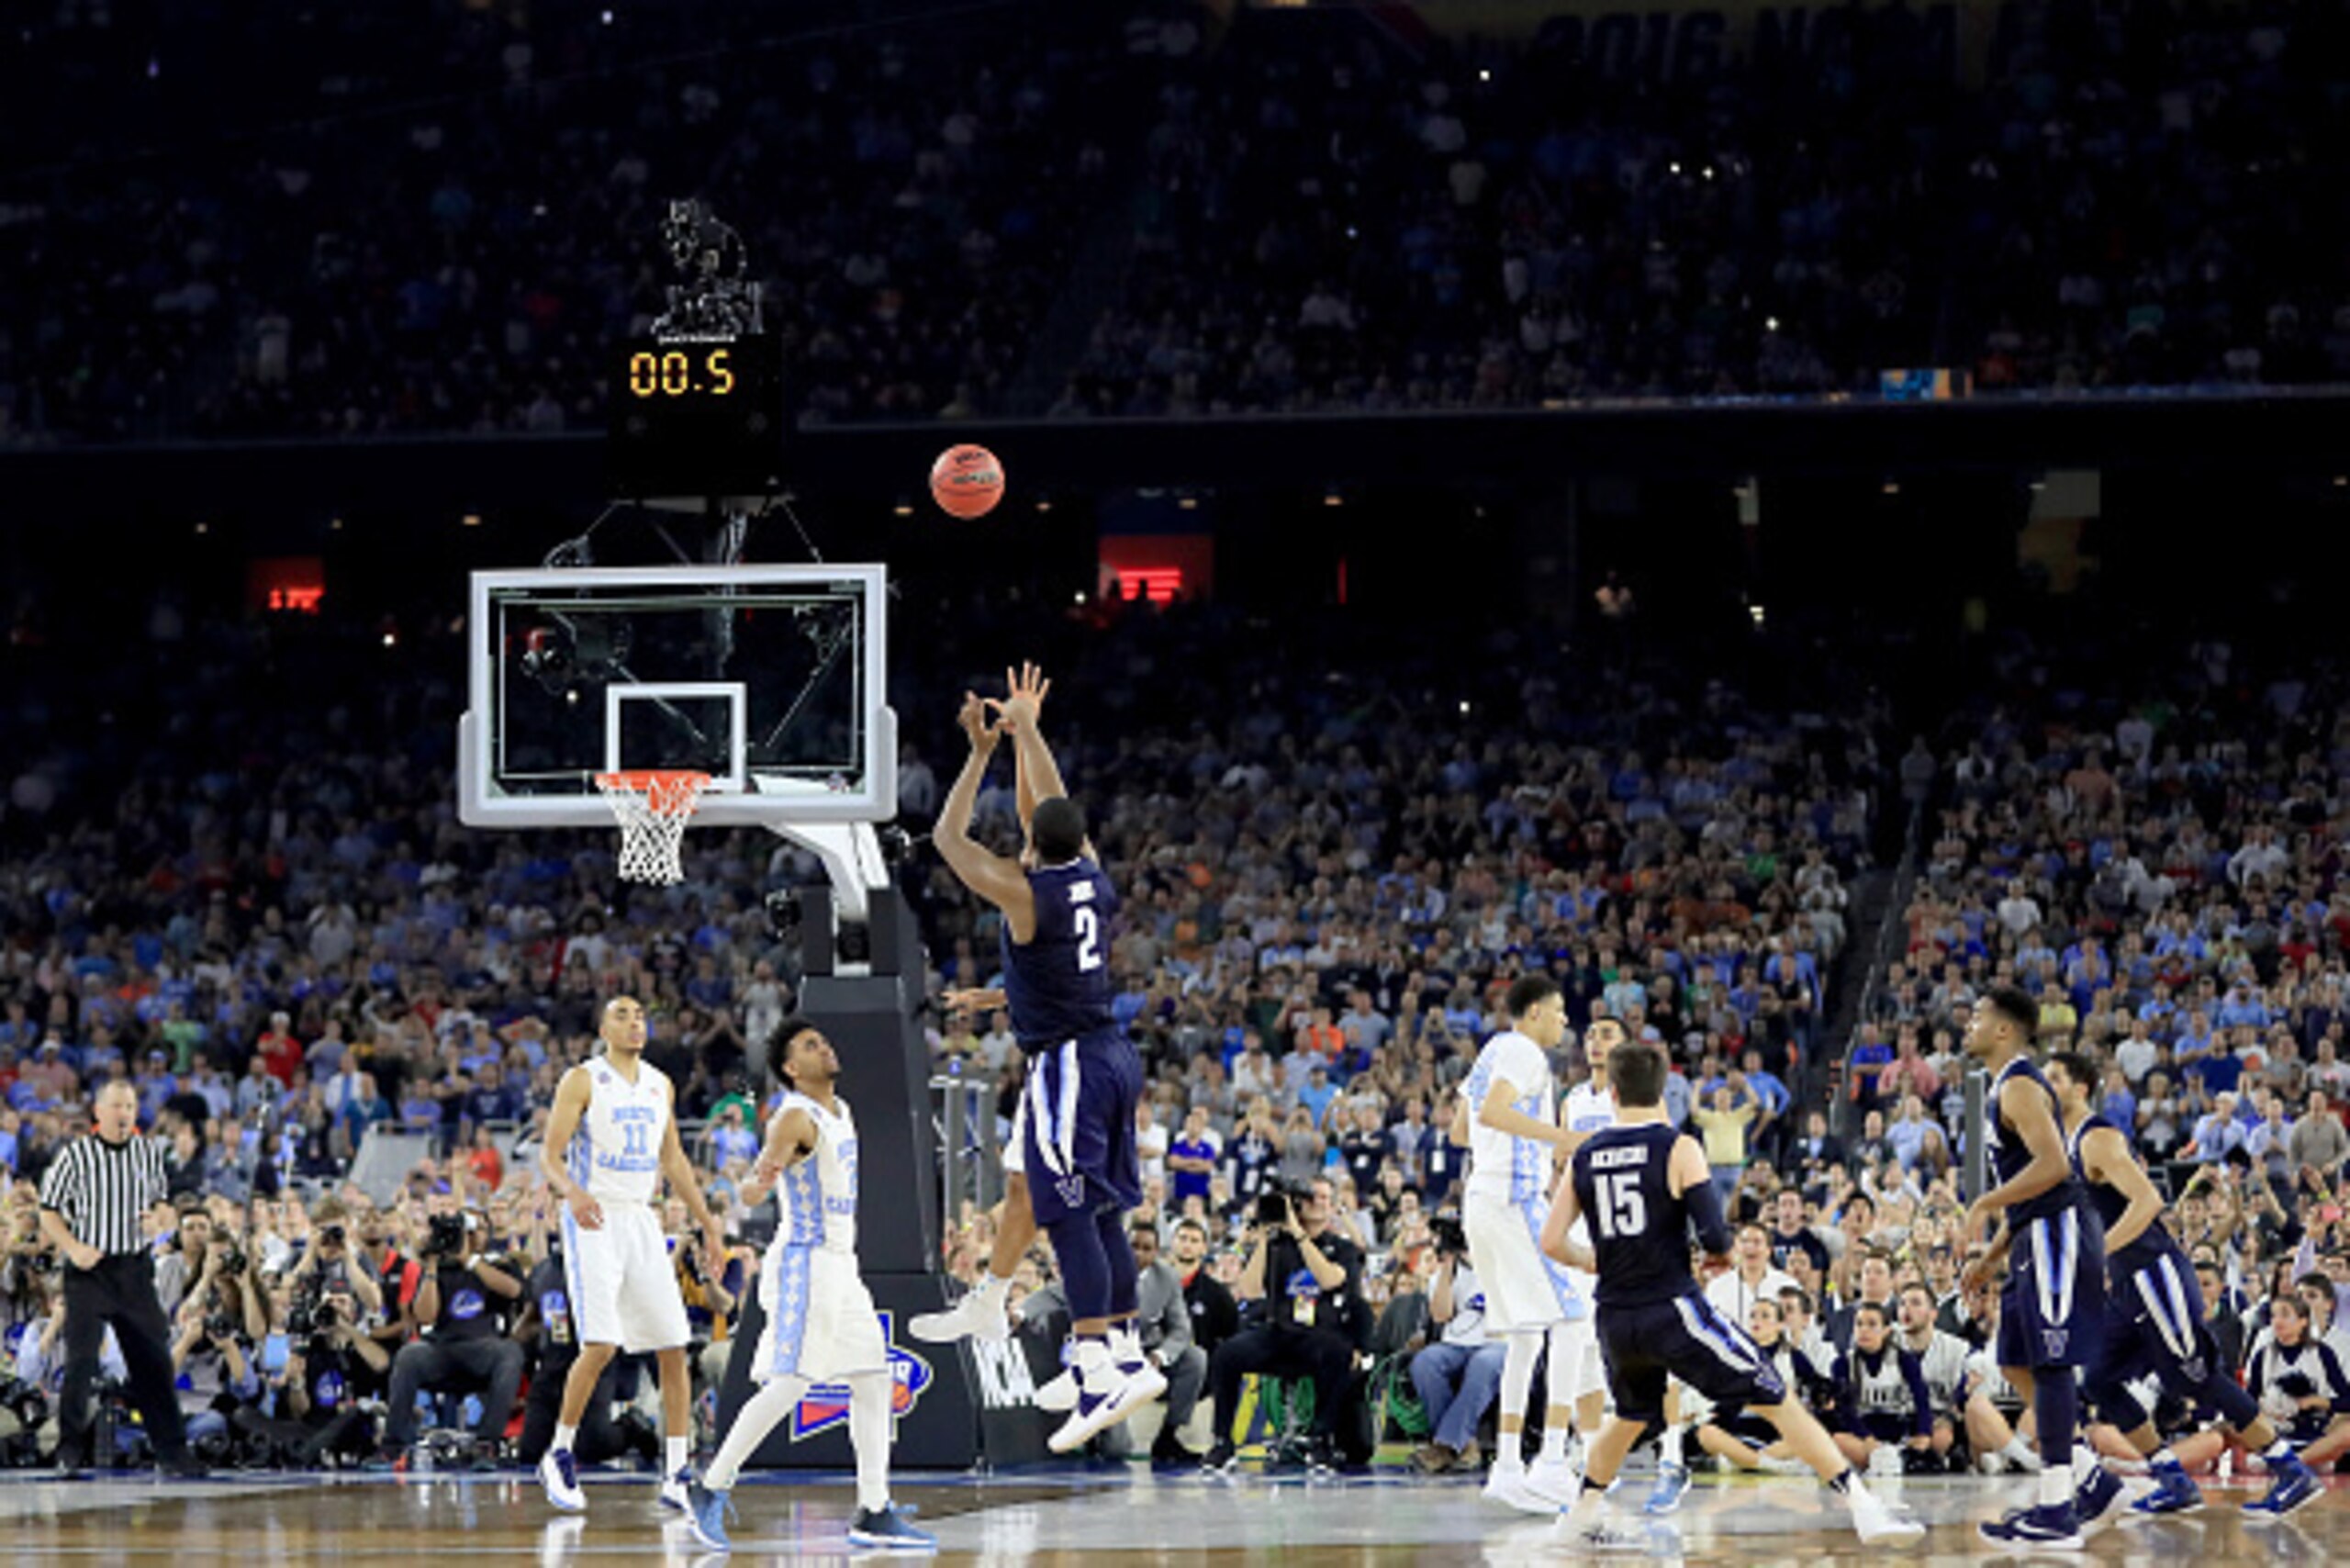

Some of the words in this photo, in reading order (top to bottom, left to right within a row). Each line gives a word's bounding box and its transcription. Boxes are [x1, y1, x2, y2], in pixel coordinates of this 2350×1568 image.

[630, 348, 734, 397] 00.5
[1075, 905, 1102, 972] 2
[623, 1123, 648, 1155] 11
[1593, 1171, 1647, 1238] 15
